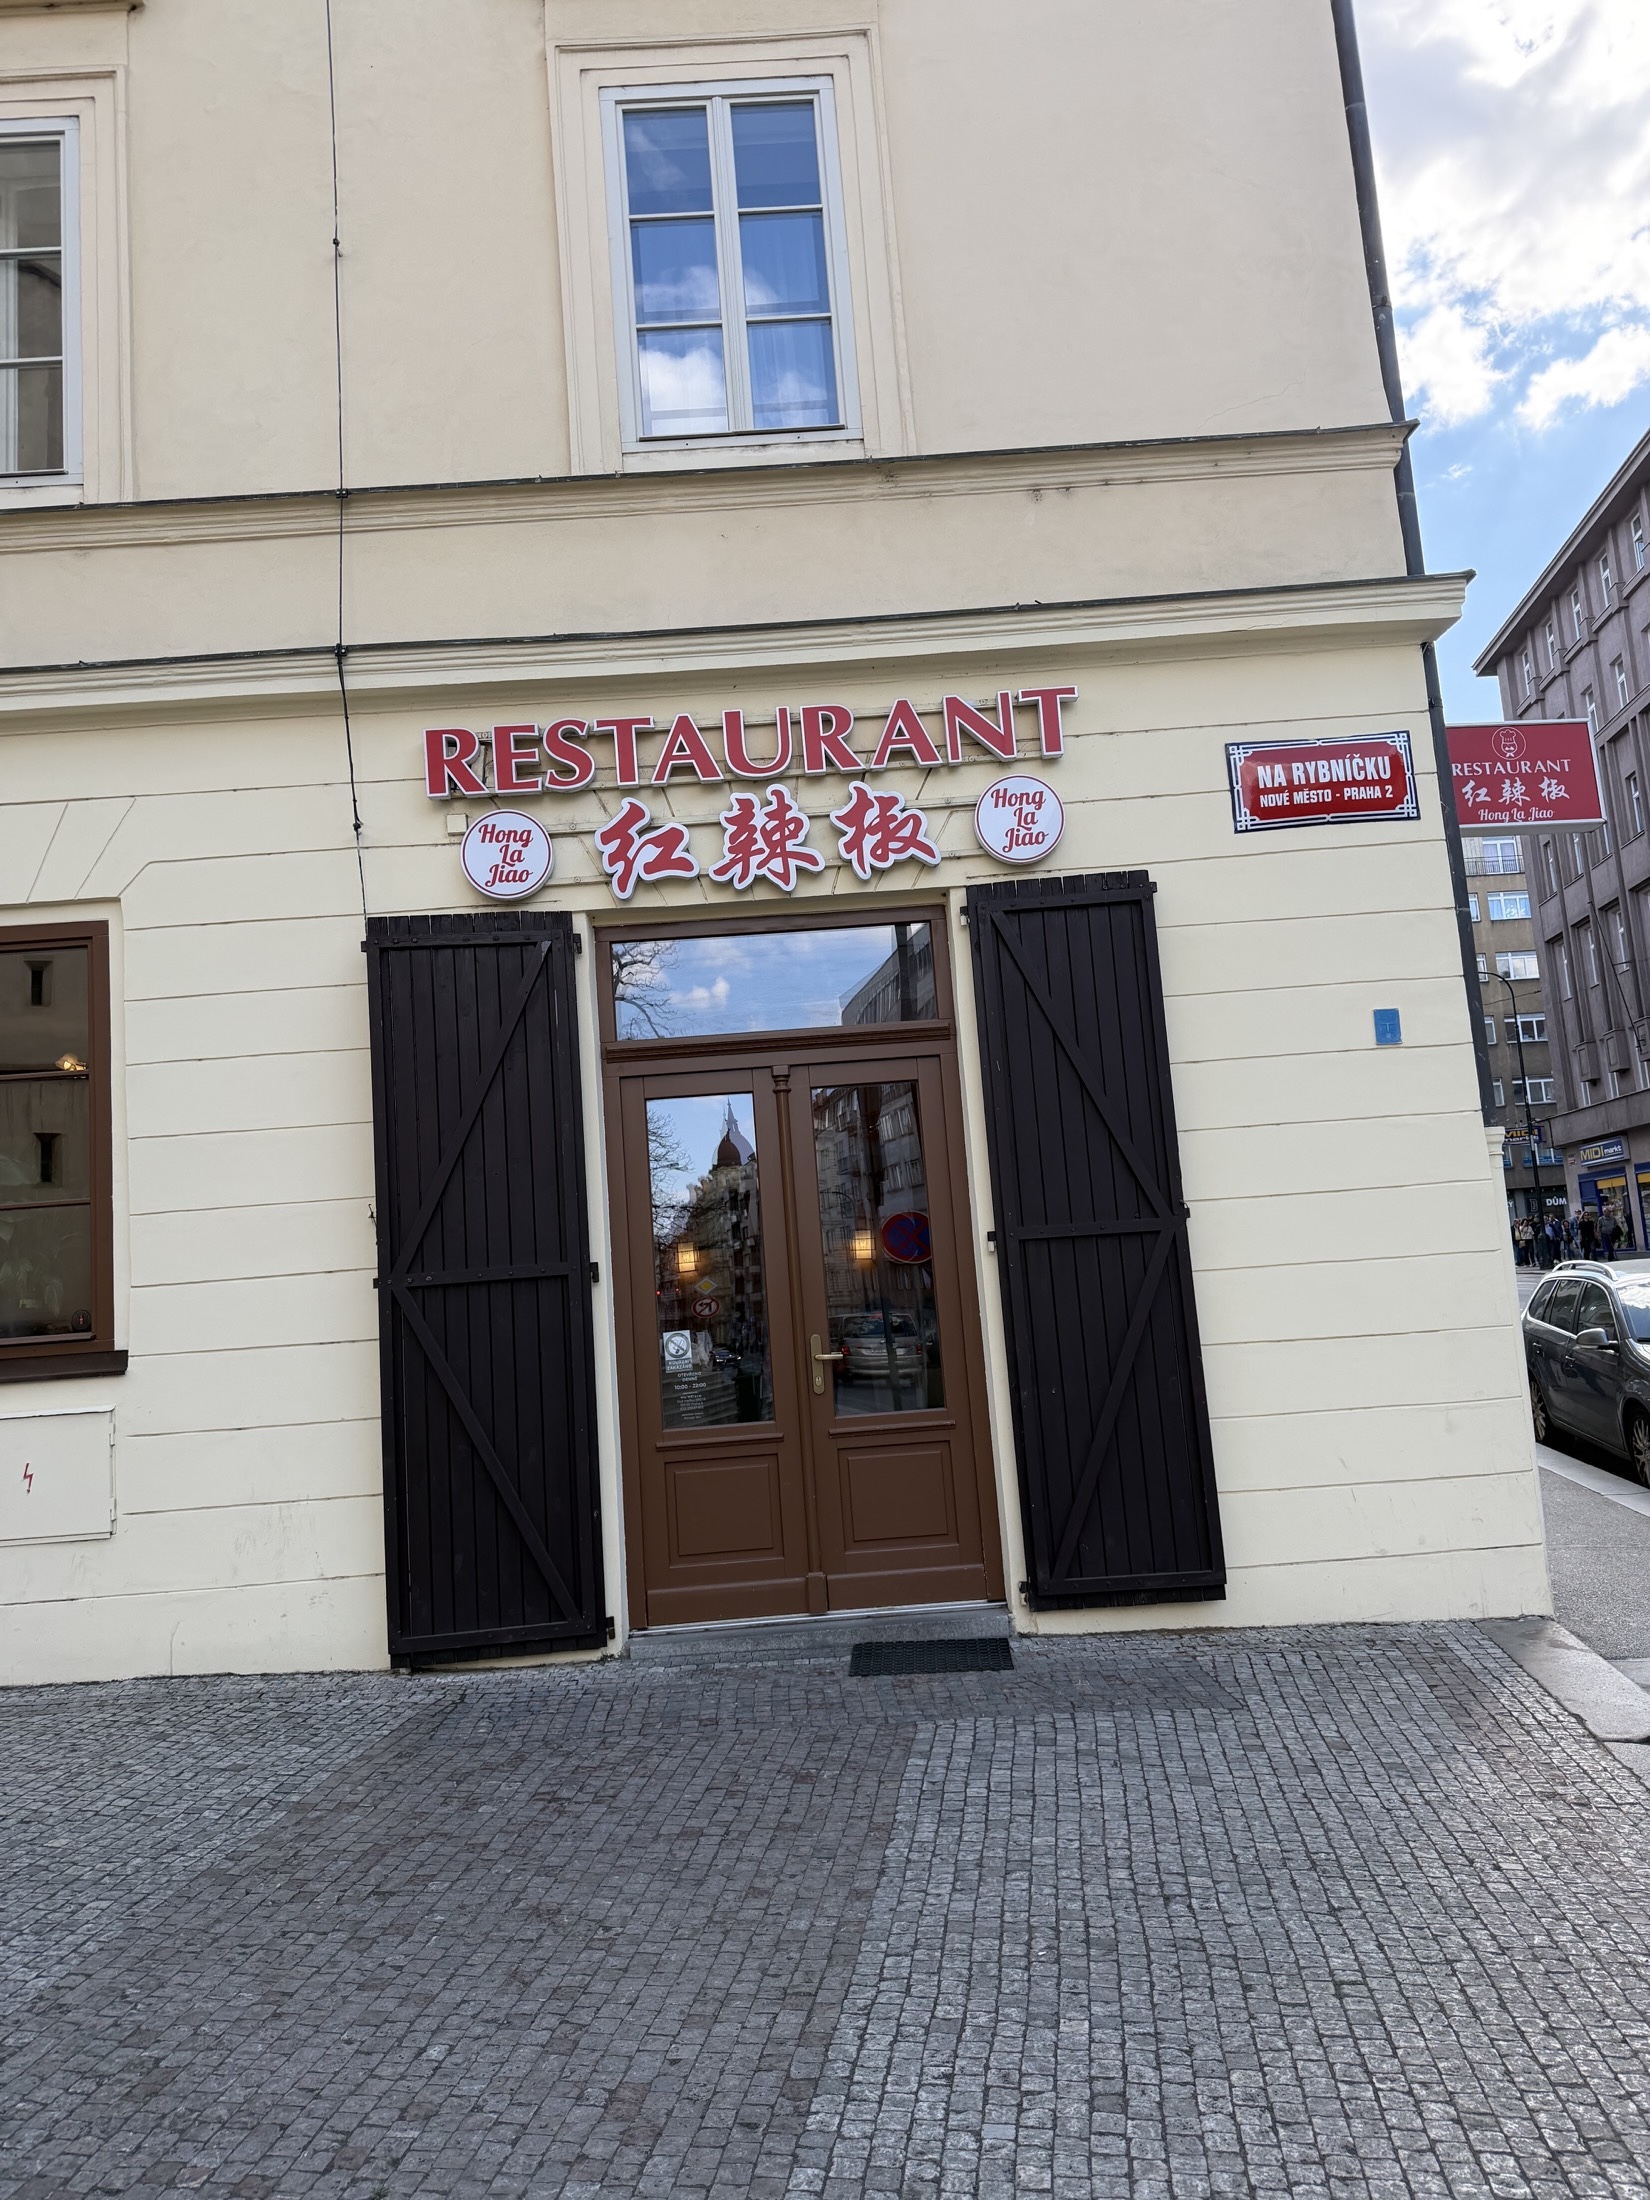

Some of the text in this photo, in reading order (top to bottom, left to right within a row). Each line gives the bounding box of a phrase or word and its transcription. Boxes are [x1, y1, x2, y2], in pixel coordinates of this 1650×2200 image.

[423, 685, 1079, 798] RESTAURANT
[1257, 753, 1392, 789] NA RYBNÍČKU
[1451, 759, 1571, 777] RESTAURANT
[991, 788, 1046, 811] Hong
[1259, 790, 1290, 808] NOVÉ
[1293, 788, 1332, 805] MĚSTO
[1344, 785, 1382, 801] PRAHA
[1385, 785, 1394, 798] 2
[1461, 776, 1571, 807] 红辣椒
[1013, 807, 1039, 831] La
[1478, 807, 1555, 823] Hong La Jiao
[478, 823, 534, 848] Hong
[595, 781, 942, 899] 红辣椒
[1002, 828, 1049, 853] Jiao
[499, 844, 525, 867] La
[485, 864, 534, 888] Jiao
[1580, 1145, 1604, 1161] MIDI
[1546, 1196, 1567, 1206] DŮM
